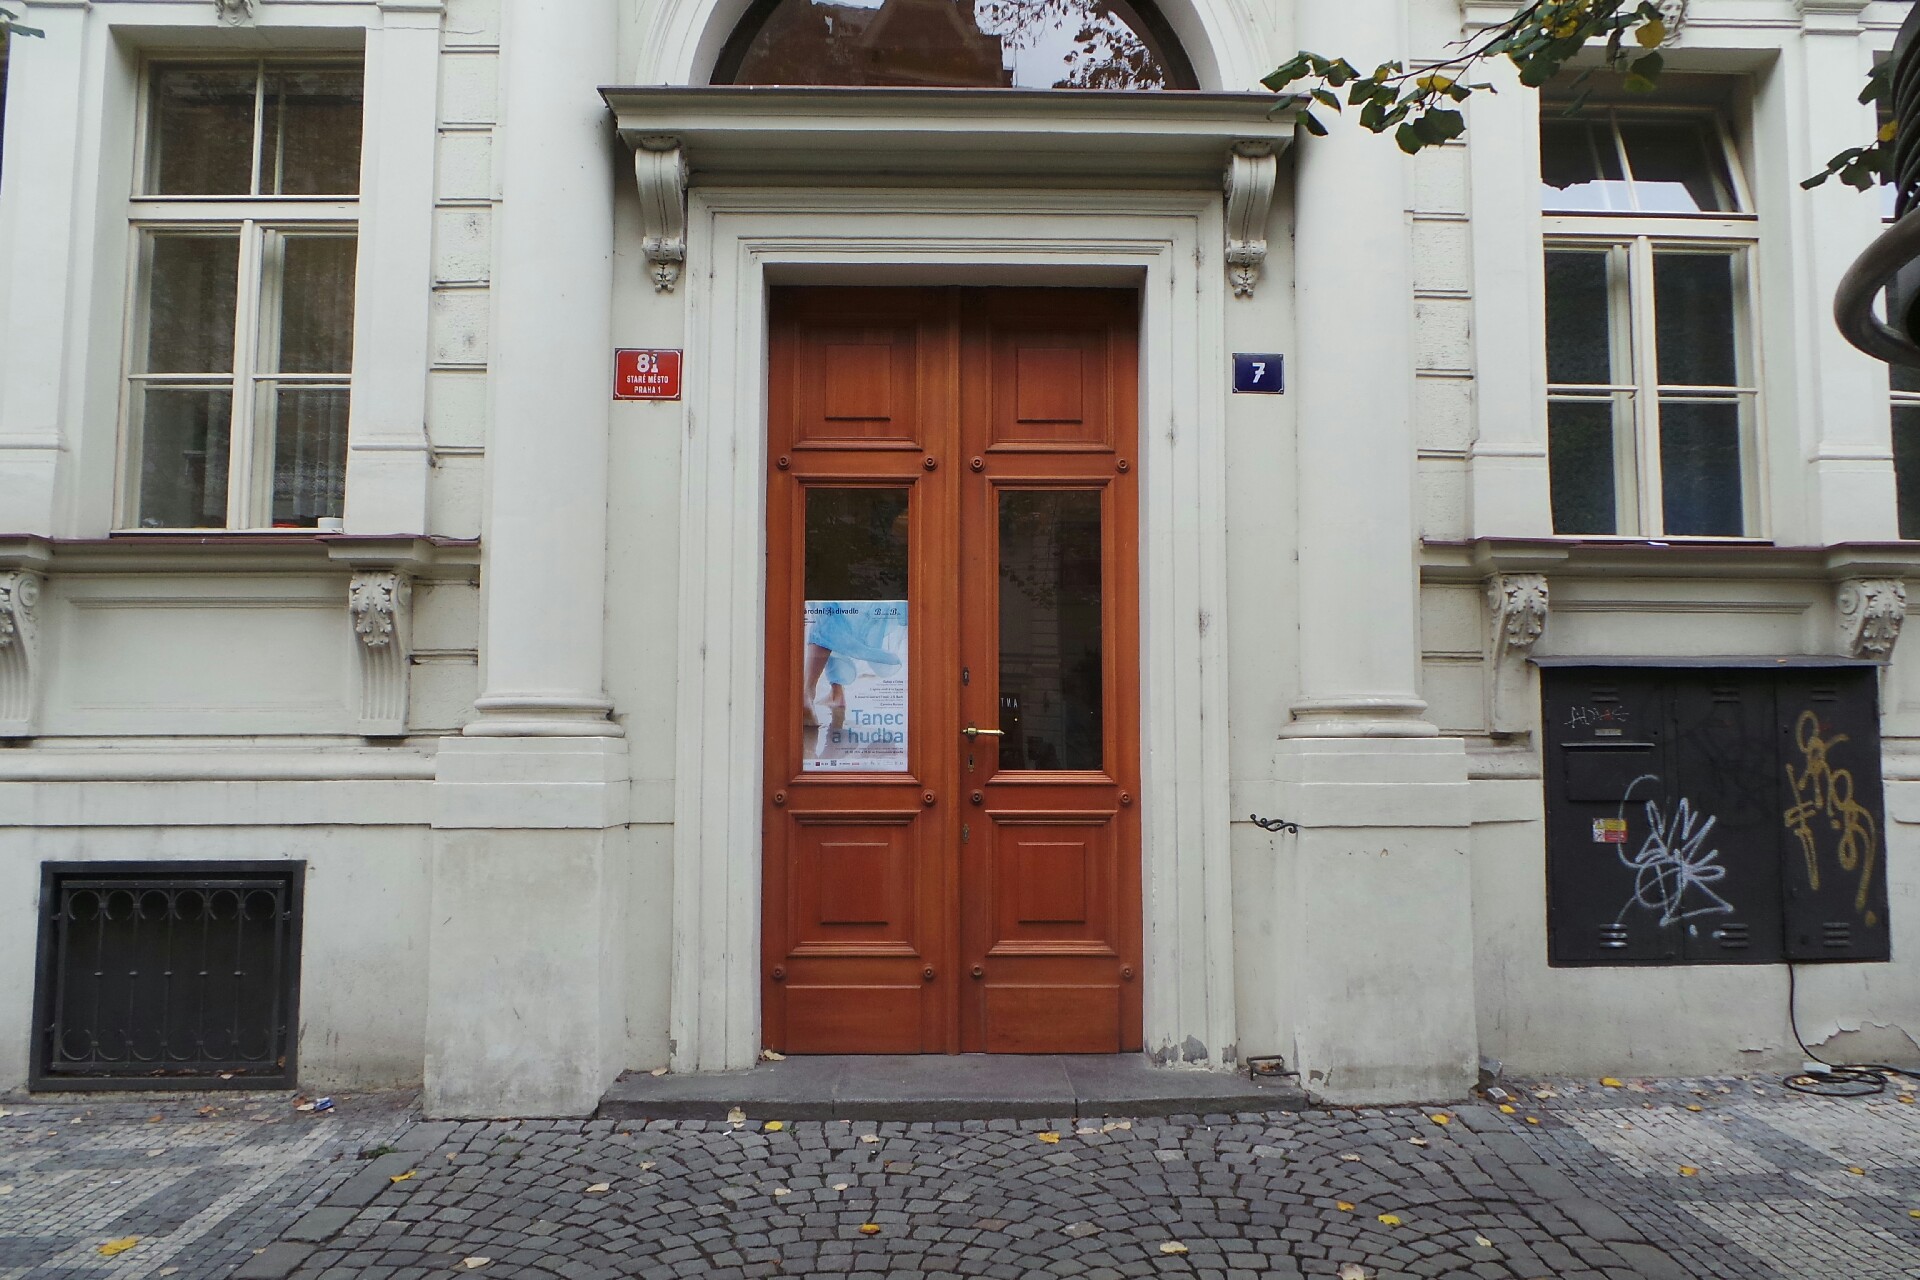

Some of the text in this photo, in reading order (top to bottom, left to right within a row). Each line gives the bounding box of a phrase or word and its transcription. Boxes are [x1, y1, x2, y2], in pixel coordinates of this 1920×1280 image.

[637, 354, 658, 372] 81
[626, 374, 668, 383] STARÉ MĚSTO
[1252, 362, 1266, 384] 7
[836, 607, 859, 615] divadlo
[851, 709, 904, 726] Tanec
[832, 727, 904, 743] a hudba
